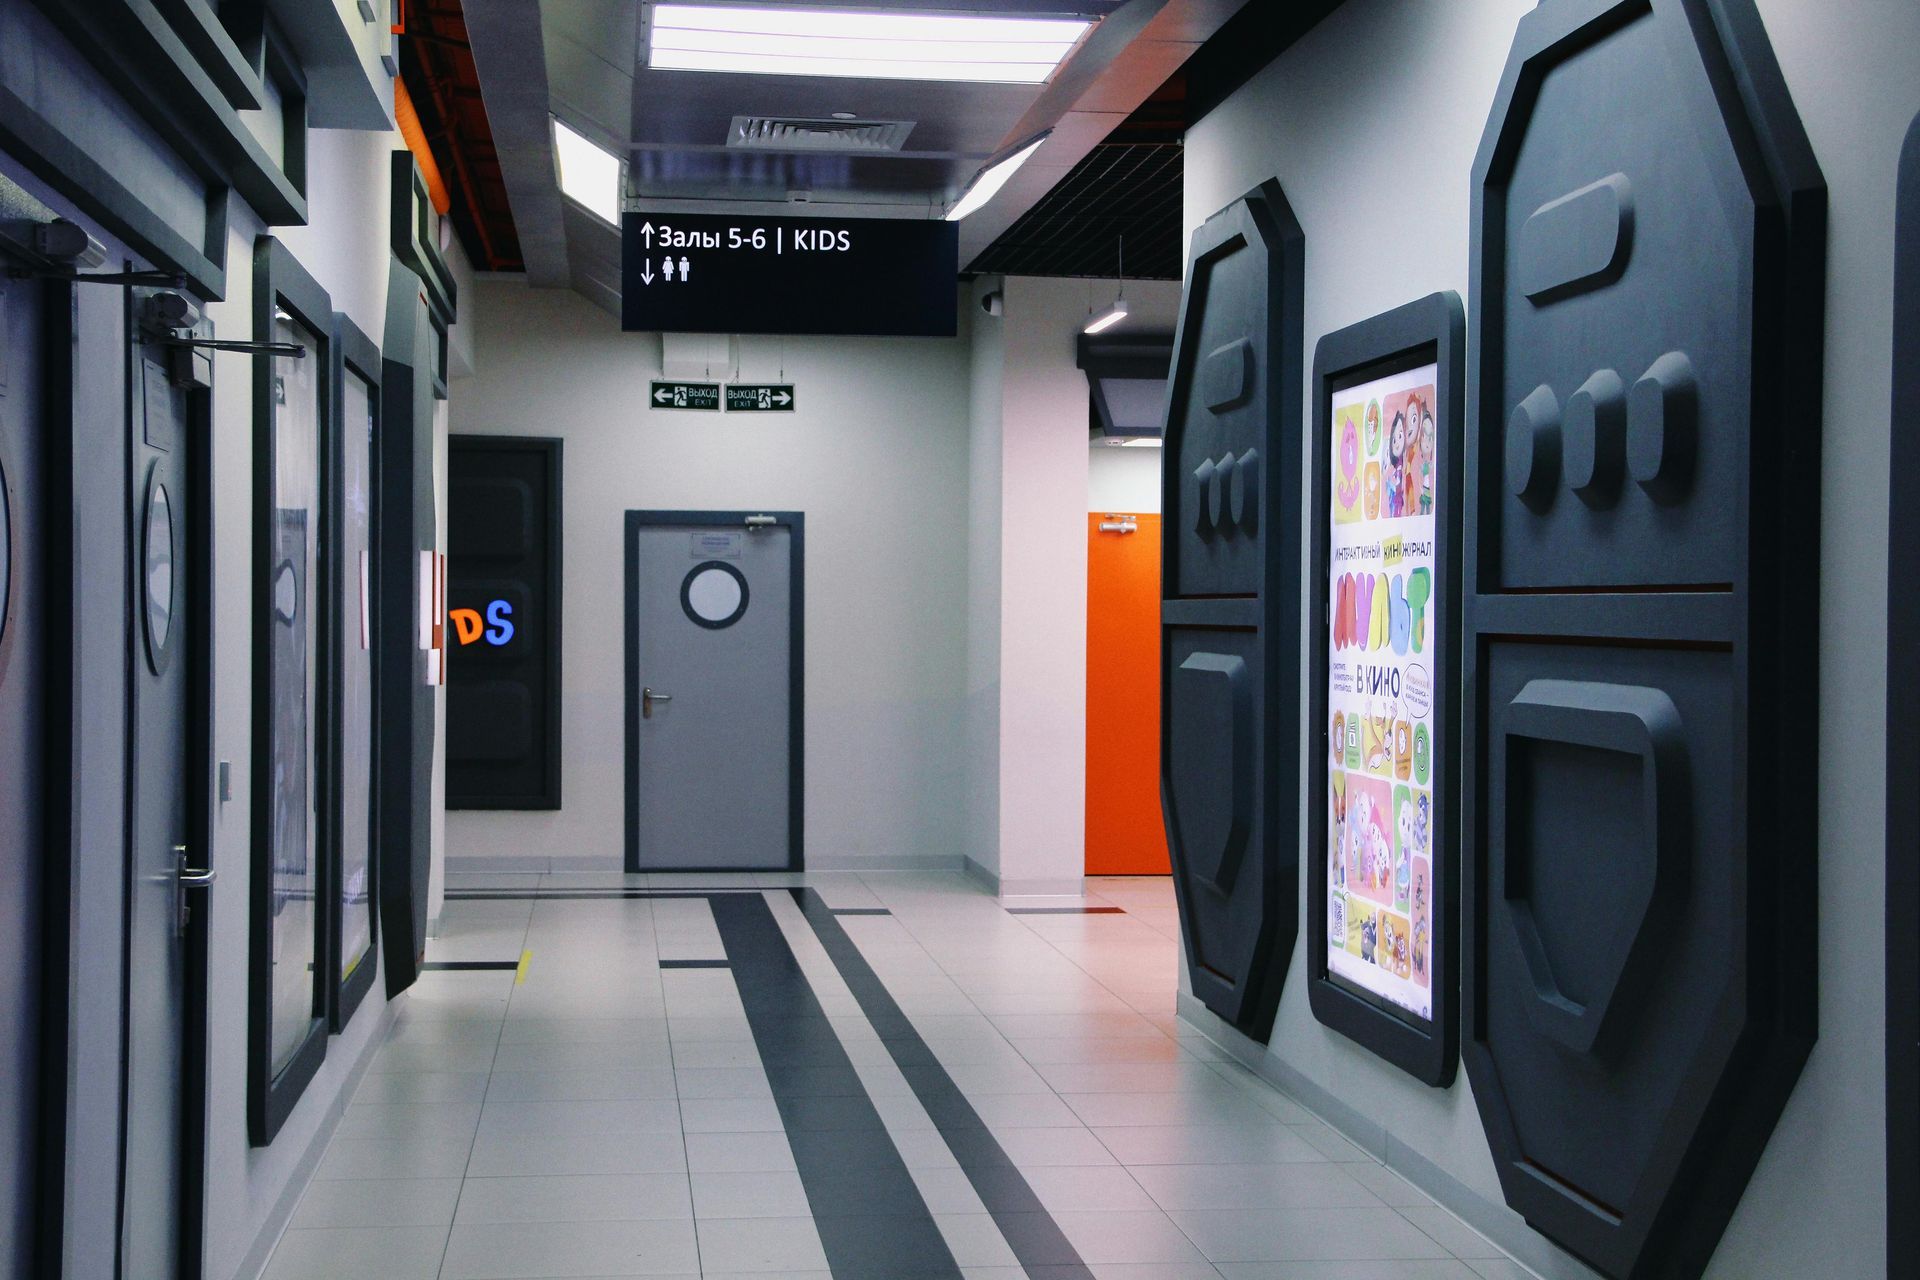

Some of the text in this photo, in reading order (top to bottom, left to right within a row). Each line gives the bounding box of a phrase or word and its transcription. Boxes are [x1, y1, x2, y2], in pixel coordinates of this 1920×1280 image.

[659, 225, 720, 248] Залы
[728, 227, 766, 249] 5-6
[794, 229, 850, 251] KIDS
[688, 387, 718, 398] ВЫХОД
[727, 389, 757, 400] ВЫХОД
[694, 398, 712, 406] EXIT
[1357, 664, 1364, 693] В
[1366, 664, 1400, 698] КИНО
